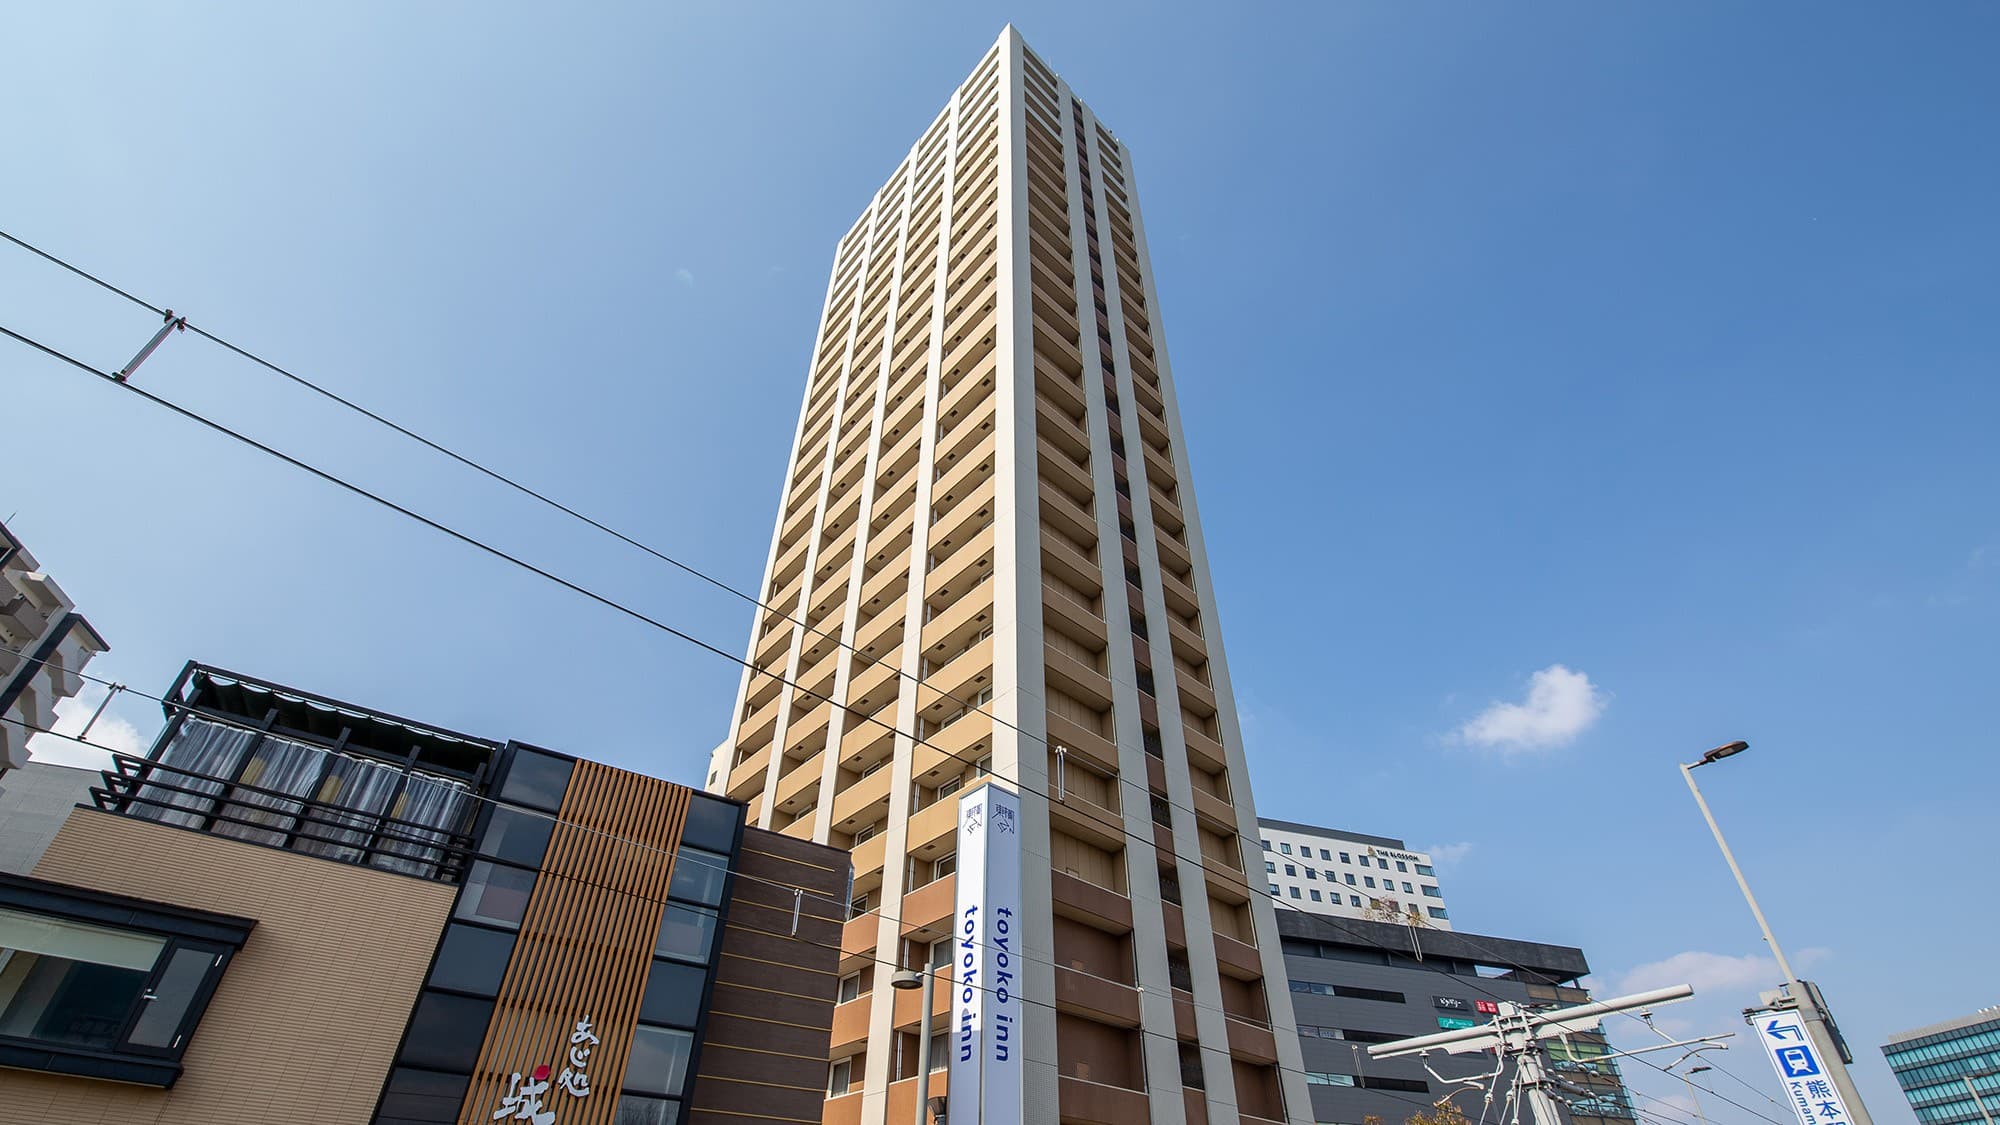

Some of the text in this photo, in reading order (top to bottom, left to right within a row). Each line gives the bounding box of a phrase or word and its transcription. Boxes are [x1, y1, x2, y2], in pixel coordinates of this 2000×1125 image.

[961, 905, 978, 1062] toyoko inn
[993, 907, 1013, 1062] toyoko inn
[1805, 1079, 1847, 1125] 熊本
